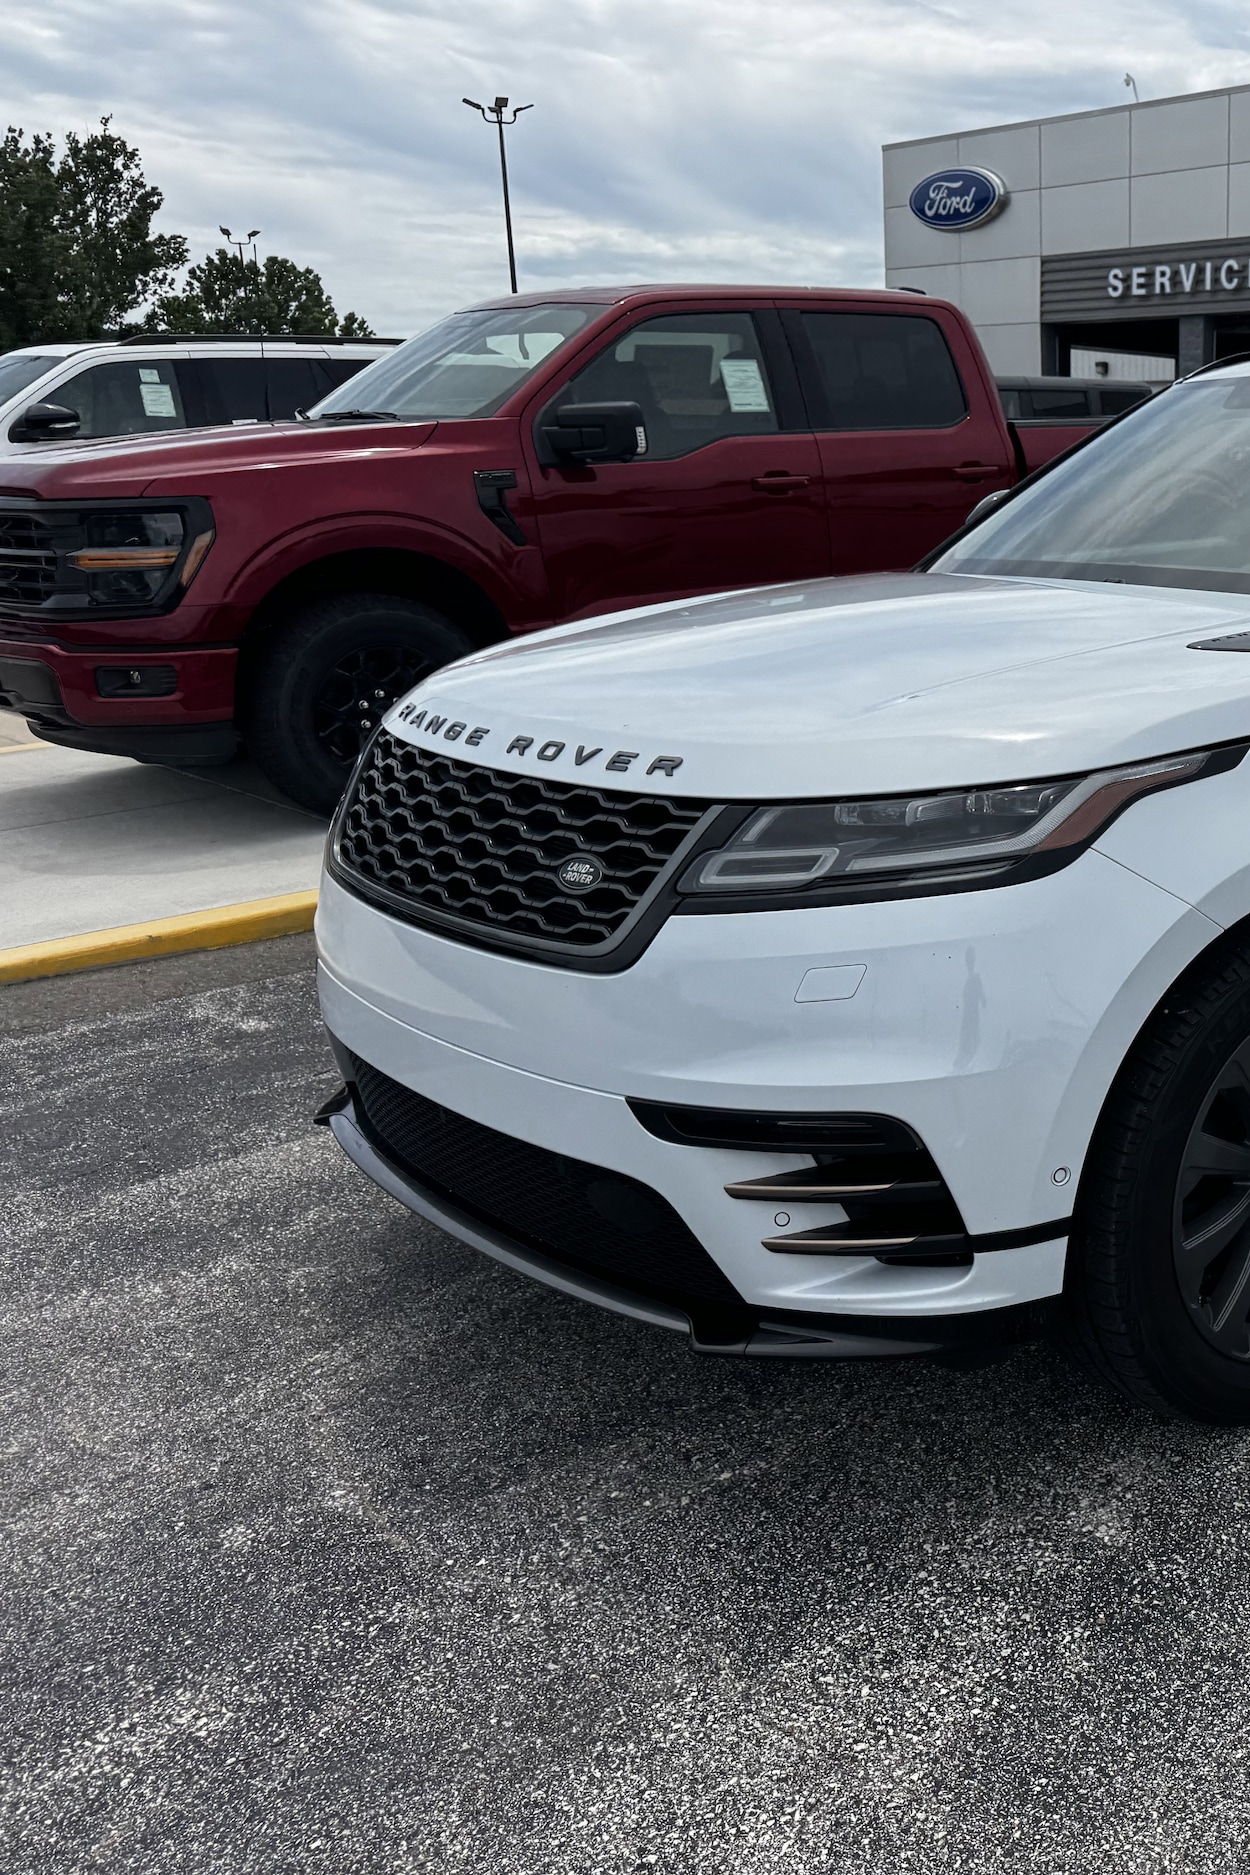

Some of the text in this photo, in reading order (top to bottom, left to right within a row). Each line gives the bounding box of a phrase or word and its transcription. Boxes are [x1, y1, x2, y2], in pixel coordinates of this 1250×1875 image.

[924, 180, 977, 217] Ford
[398, 702, 684, 777] RANGE ROVER
